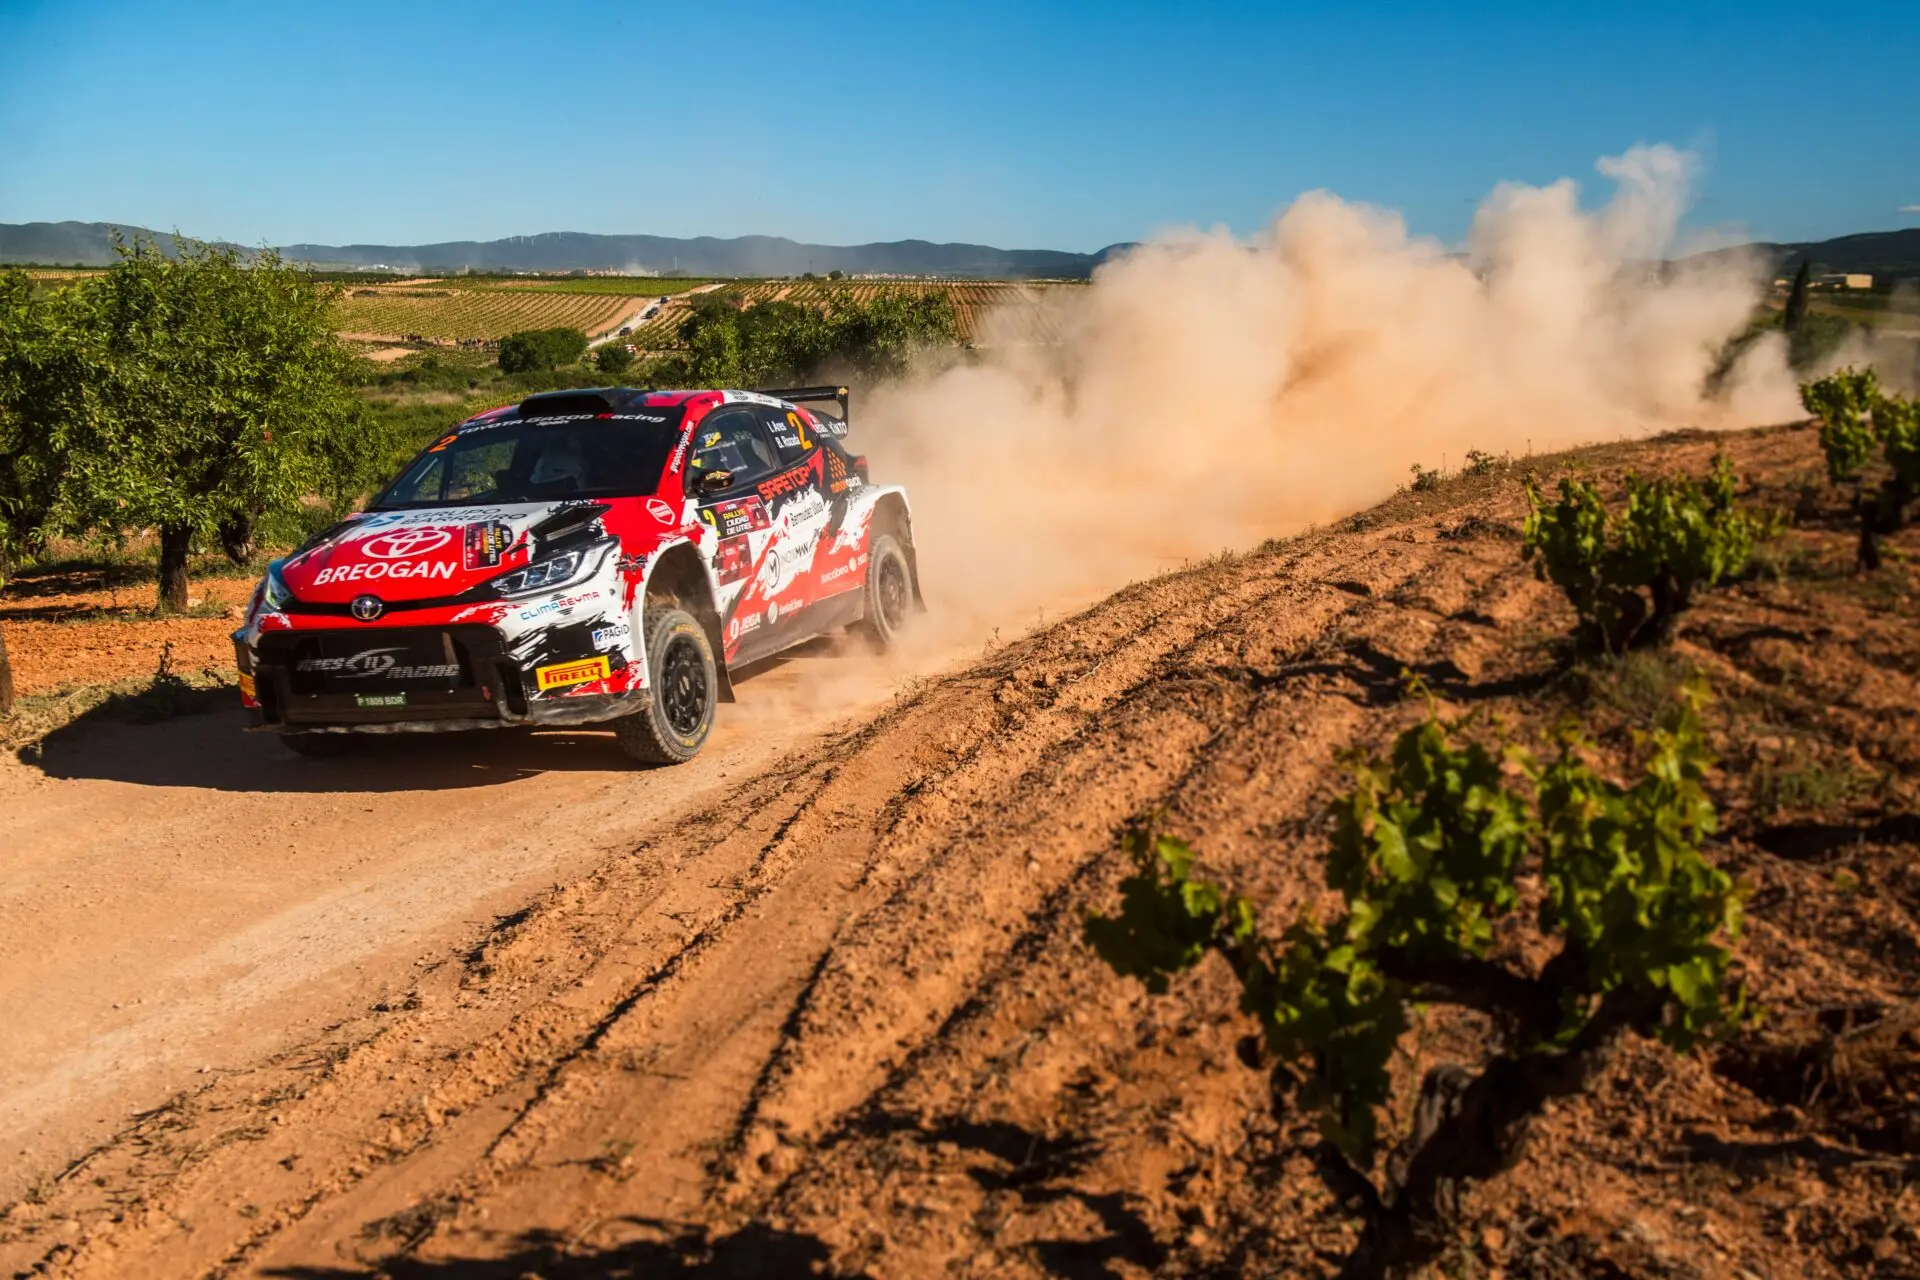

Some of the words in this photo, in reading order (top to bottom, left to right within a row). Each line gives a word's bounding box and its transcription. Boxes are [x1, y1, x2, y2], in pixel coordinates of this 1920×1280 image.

[458, 420, 523, 436] TOYOTA
[525, 413, 594, 423] GAZOO
[596, 413, 666, 423] Racing
[786, 411, 813, 451] 2
[427, 435, 458, 453] 2
[757, 464, 811, 500] SAFETOP
[401, 513, 528, 525] BARREIRO
[413, 508, 502, 519] GRUPO
[722, 508, 746, 520] RALLYE
[726, 515, 750, 527] CIUDAD
[726, 526, 737, 536] DE
[313, 560, 458, 586] BREOGAN
[603, 624, 630, 640] PAGID
[544, 661, 604, 684] PIRELLI
